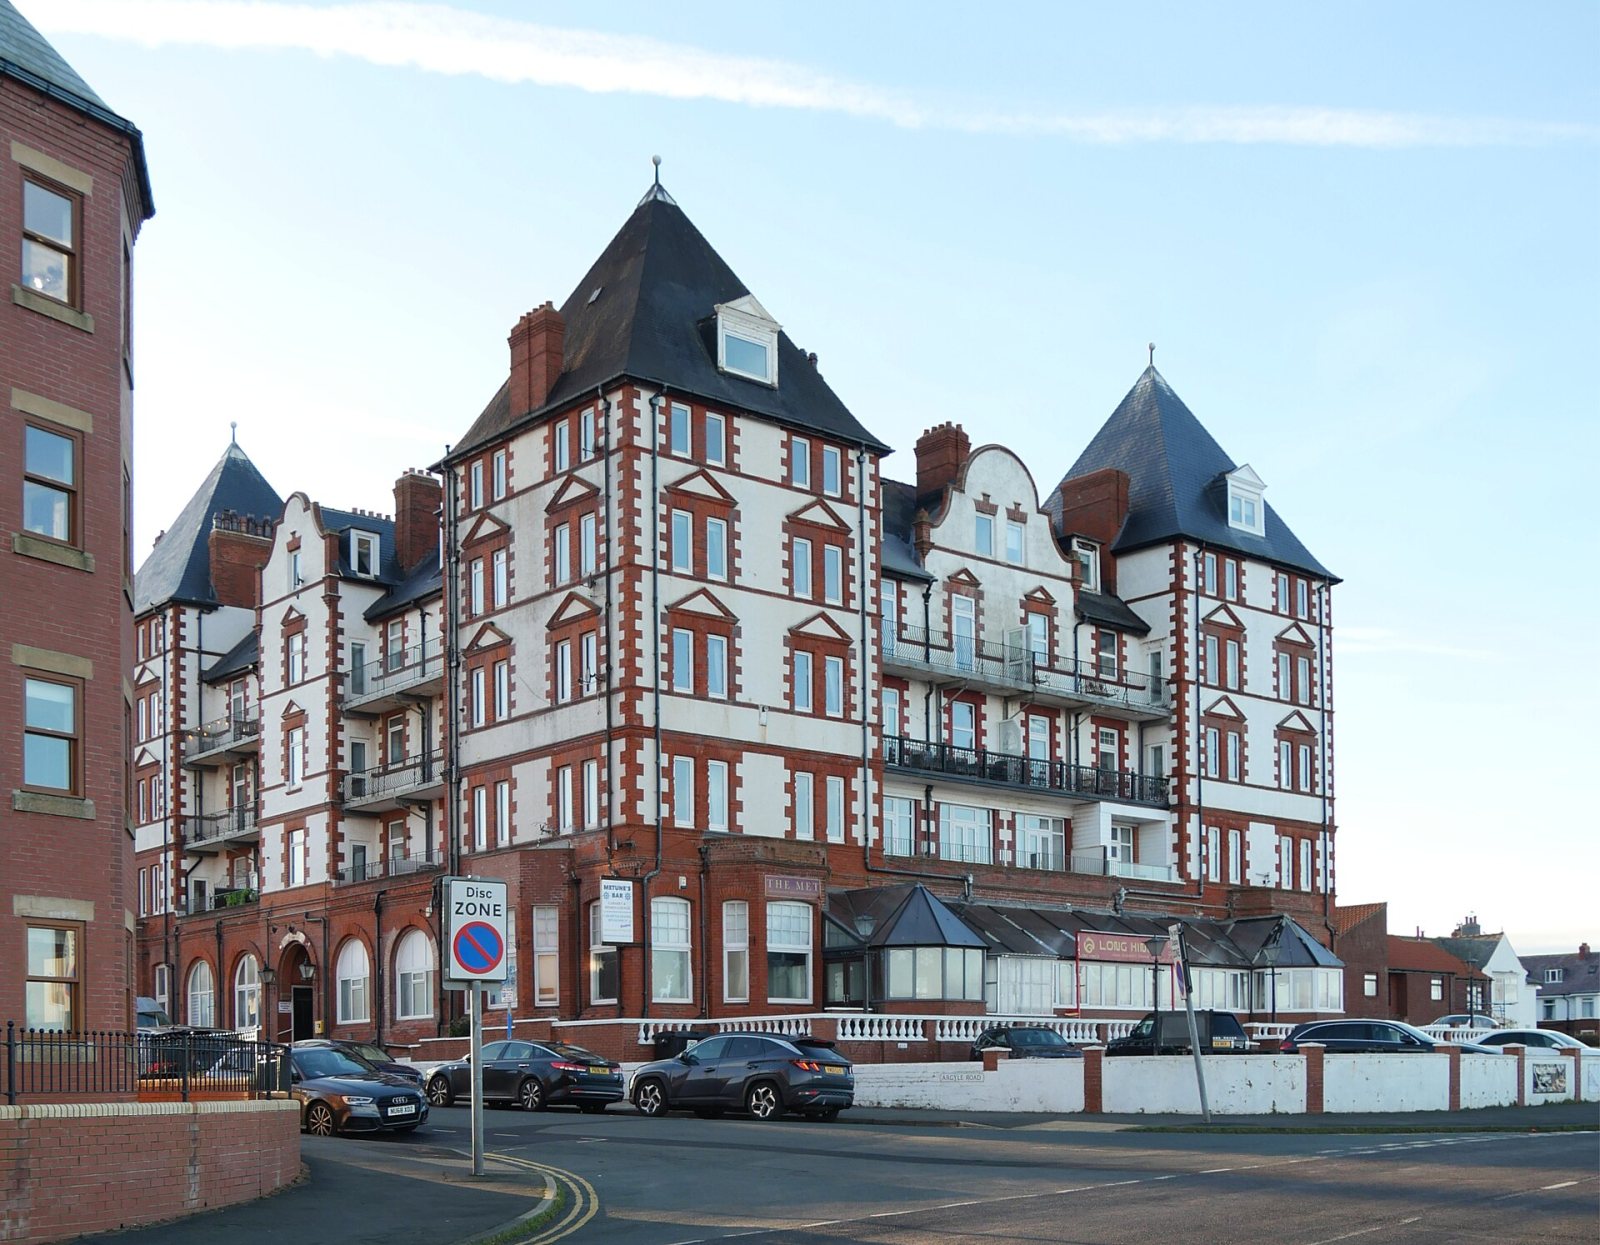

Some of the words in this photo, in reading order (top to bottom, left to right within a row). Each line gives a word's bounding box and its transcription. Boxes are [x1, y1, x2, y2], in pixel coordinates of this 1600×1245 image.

[766, 879, 790, 890] THE
[795, 881, 818, 892] MET
[466, 886, 492, 899] Disc
[455, 901, 502, 917] ZONE
[1099, 940, 1128, 952] LONG
